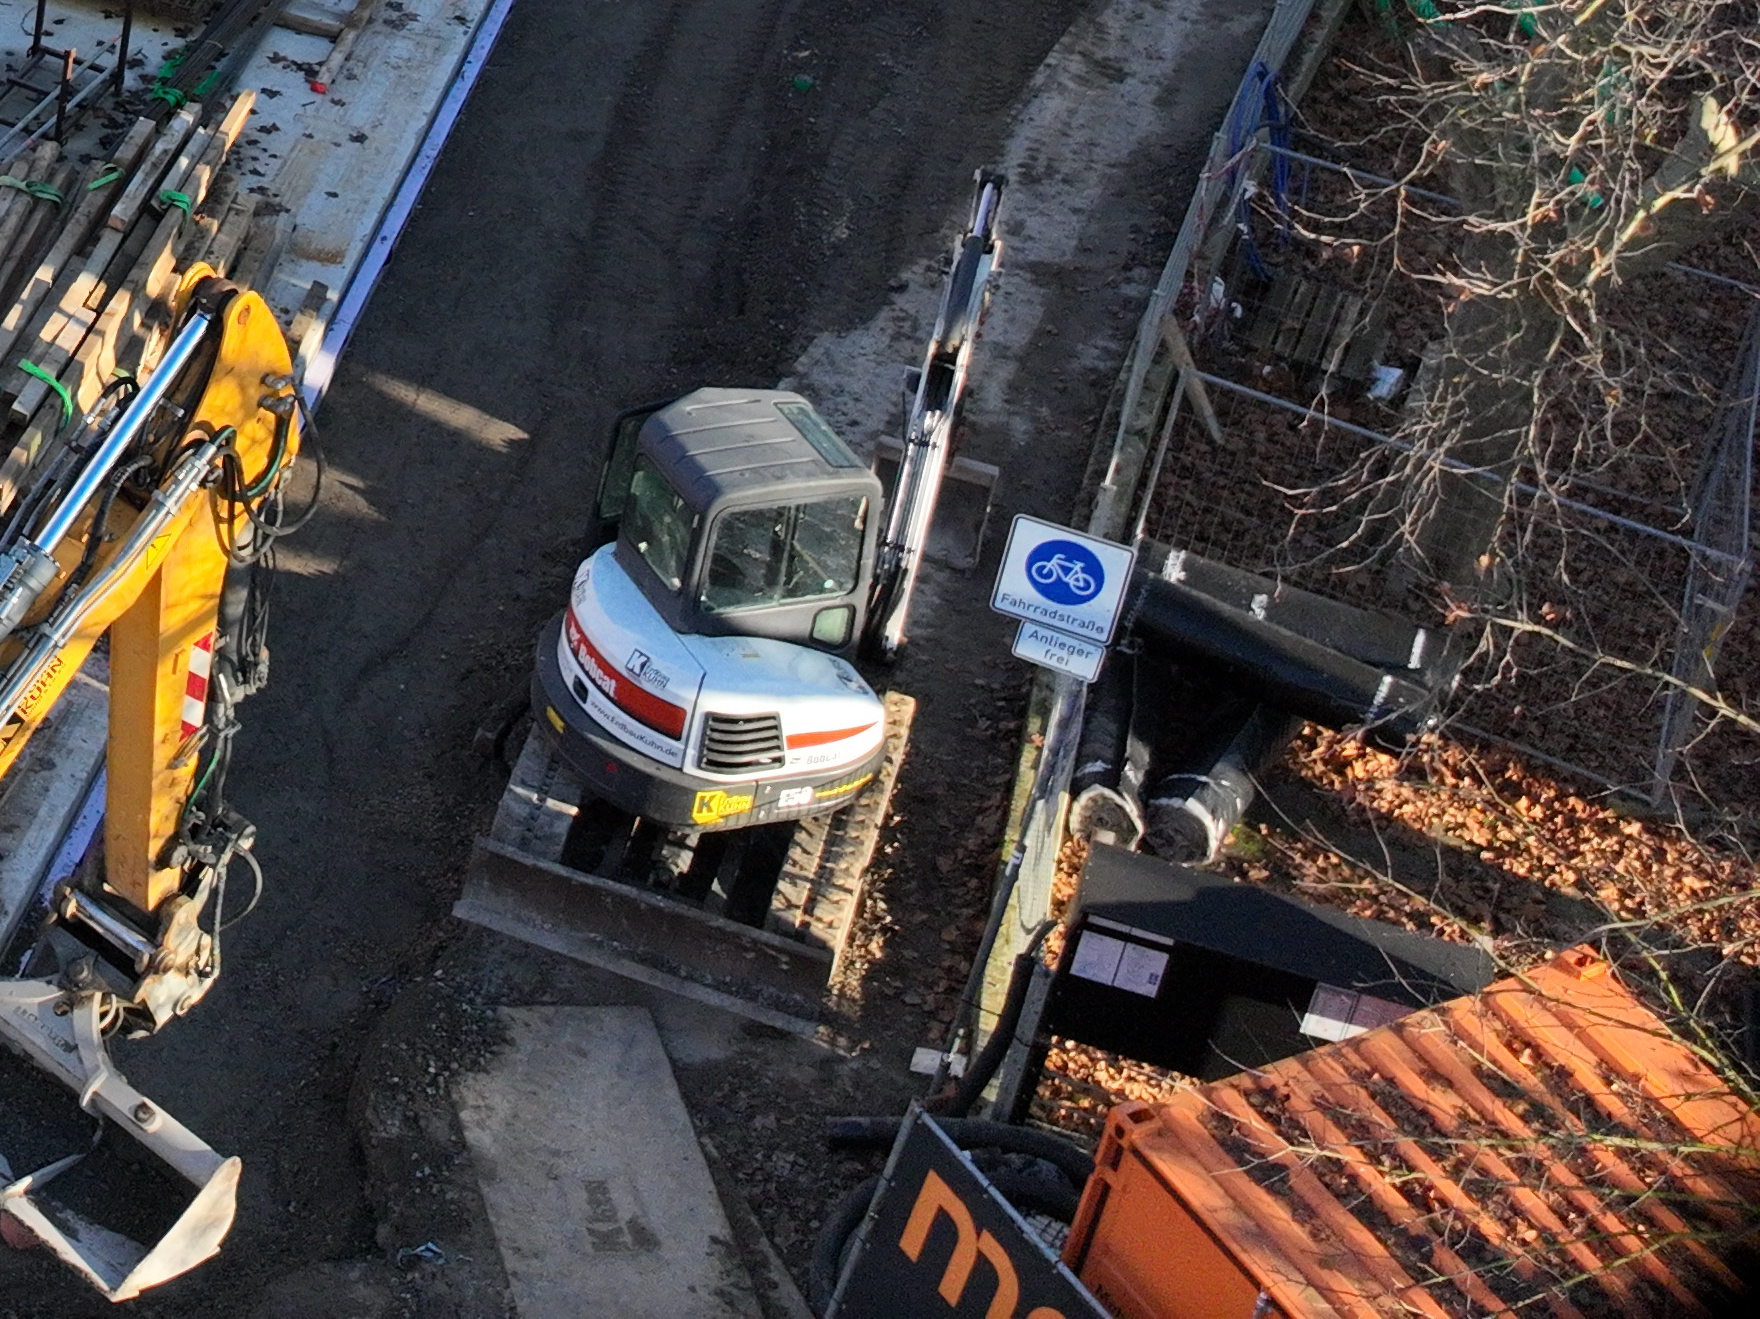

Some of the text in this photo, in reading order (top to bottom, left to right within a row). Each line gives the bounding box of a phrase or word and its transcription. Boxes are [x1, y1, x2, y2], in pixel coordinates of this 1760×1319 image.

[1000, 592, 1105, 635] Fahrradstraße
[1028, 629, 1094, 660] Anlieger
[1043, 648, 1070, 667] frei
[577, 645, 618, 700] Bobcat
[899, 1168, 1066, 1319] m
